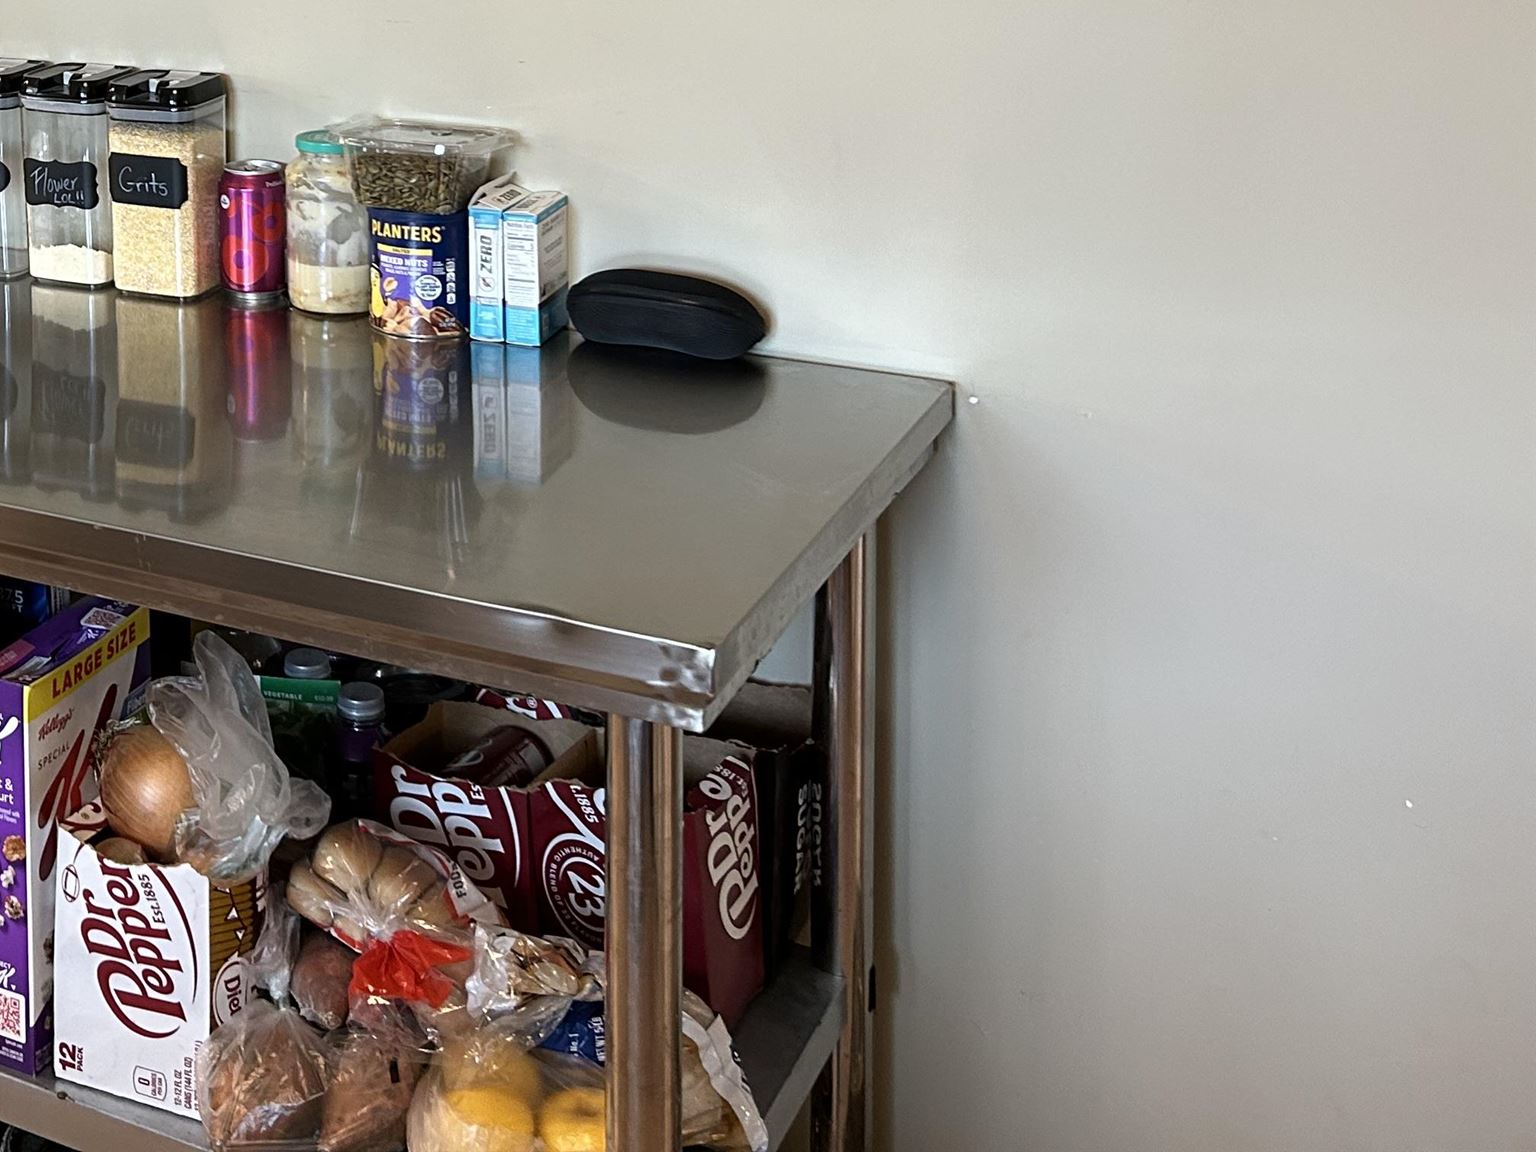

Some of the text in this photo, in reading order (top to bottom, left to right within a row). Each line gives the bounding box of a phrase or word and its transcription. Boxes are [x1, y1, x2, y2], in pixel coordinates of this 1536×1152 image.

[30, 166, 79, 196] Flower
[118, 166, 169, 197] Grits
[54, 190, 85, 205] LOL!!
[501, 189, 522, 203] ZERO
[371, 218, 443, 244] PLANTERS
[404, 257, 429, 268] NUTS
[479, 235, 493, 274] ZERO
[52, 622, 137, 698] LARGE SIZE
[38, 741, 70, 770] SPECIAL
[5, 778, 14, 791] &
[390, 764, 453, 848] Dr
[705, 809, 739, 887] Dr
[567, 870, 605, 919] 23
[80, 888, 134, 965] Dr
[59, 1042, 77, 1071] 12
[75, 1047, 84, 1072] PACK
[138, 1076, 150, 1087] 0
[174, 1069, 182, 1079] OZ
[184, 1091, 192, 1109] CANS
